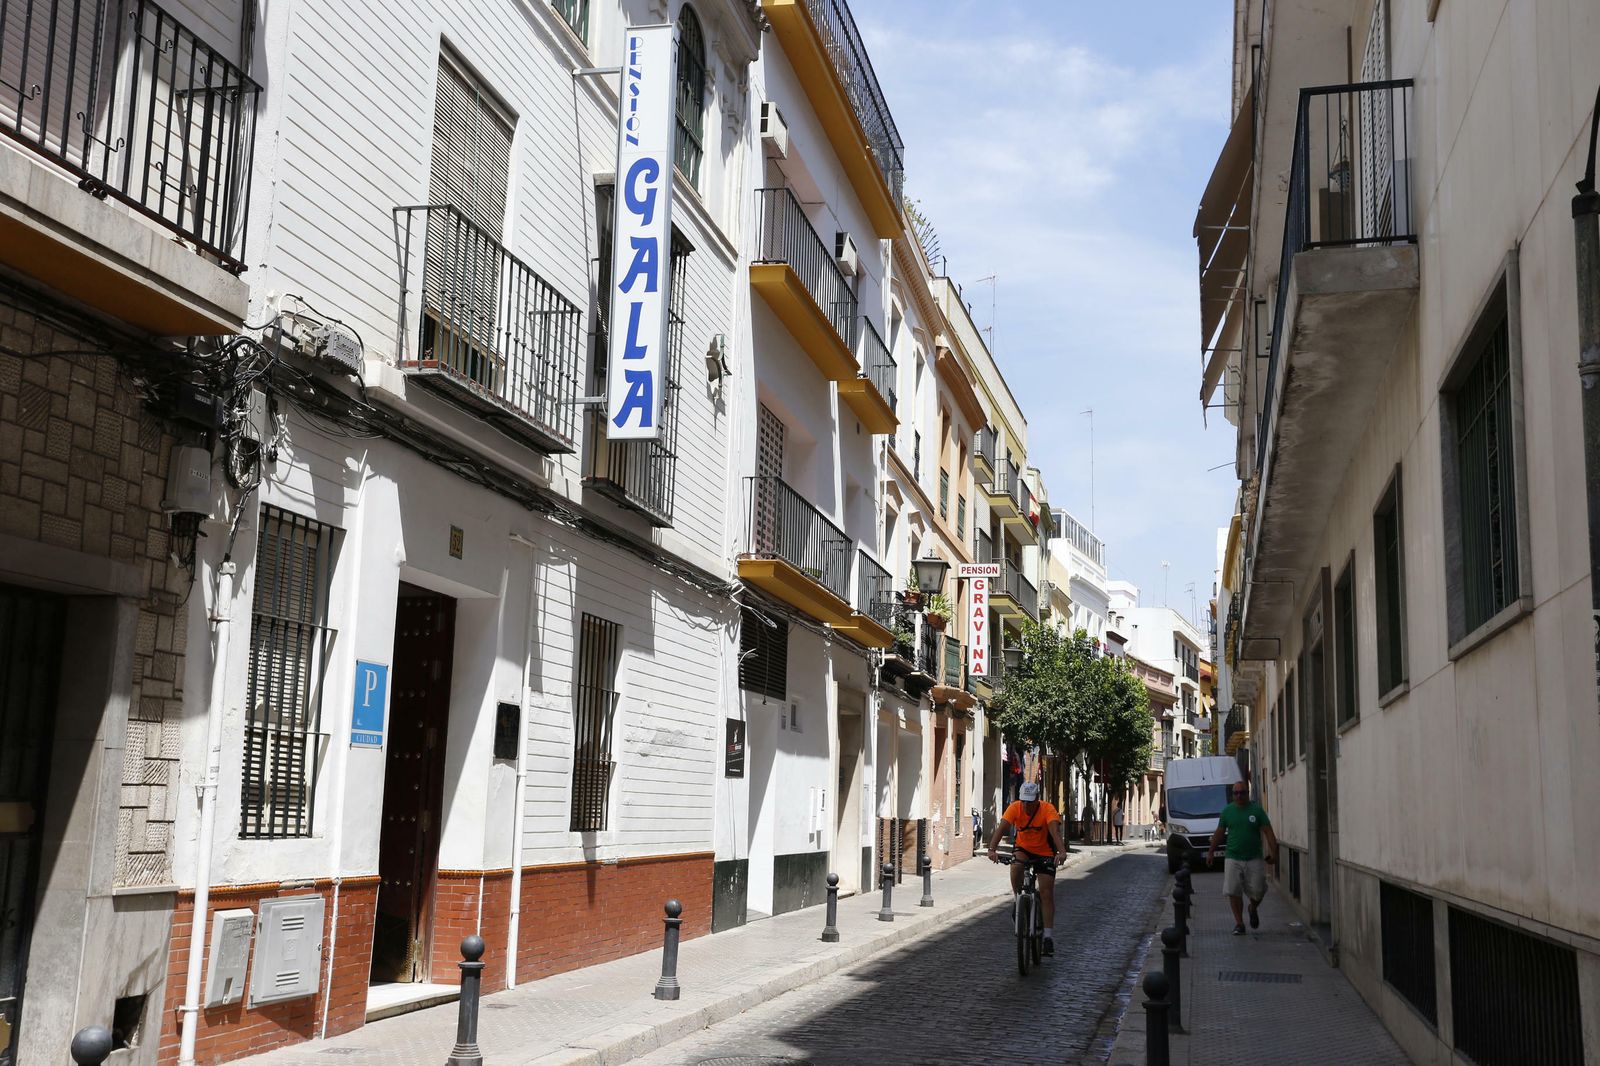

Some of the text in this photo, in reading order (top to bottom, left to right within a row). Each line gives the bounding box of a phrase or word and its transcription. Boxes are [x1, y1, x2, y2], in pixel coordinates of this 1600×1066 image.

[625, 36, 643, 148] PENSIÓN
[612, 156, 660, 429] GALA
[972, 579, 985, 674] GRAVINA
[362, 669, 378, 707] P
